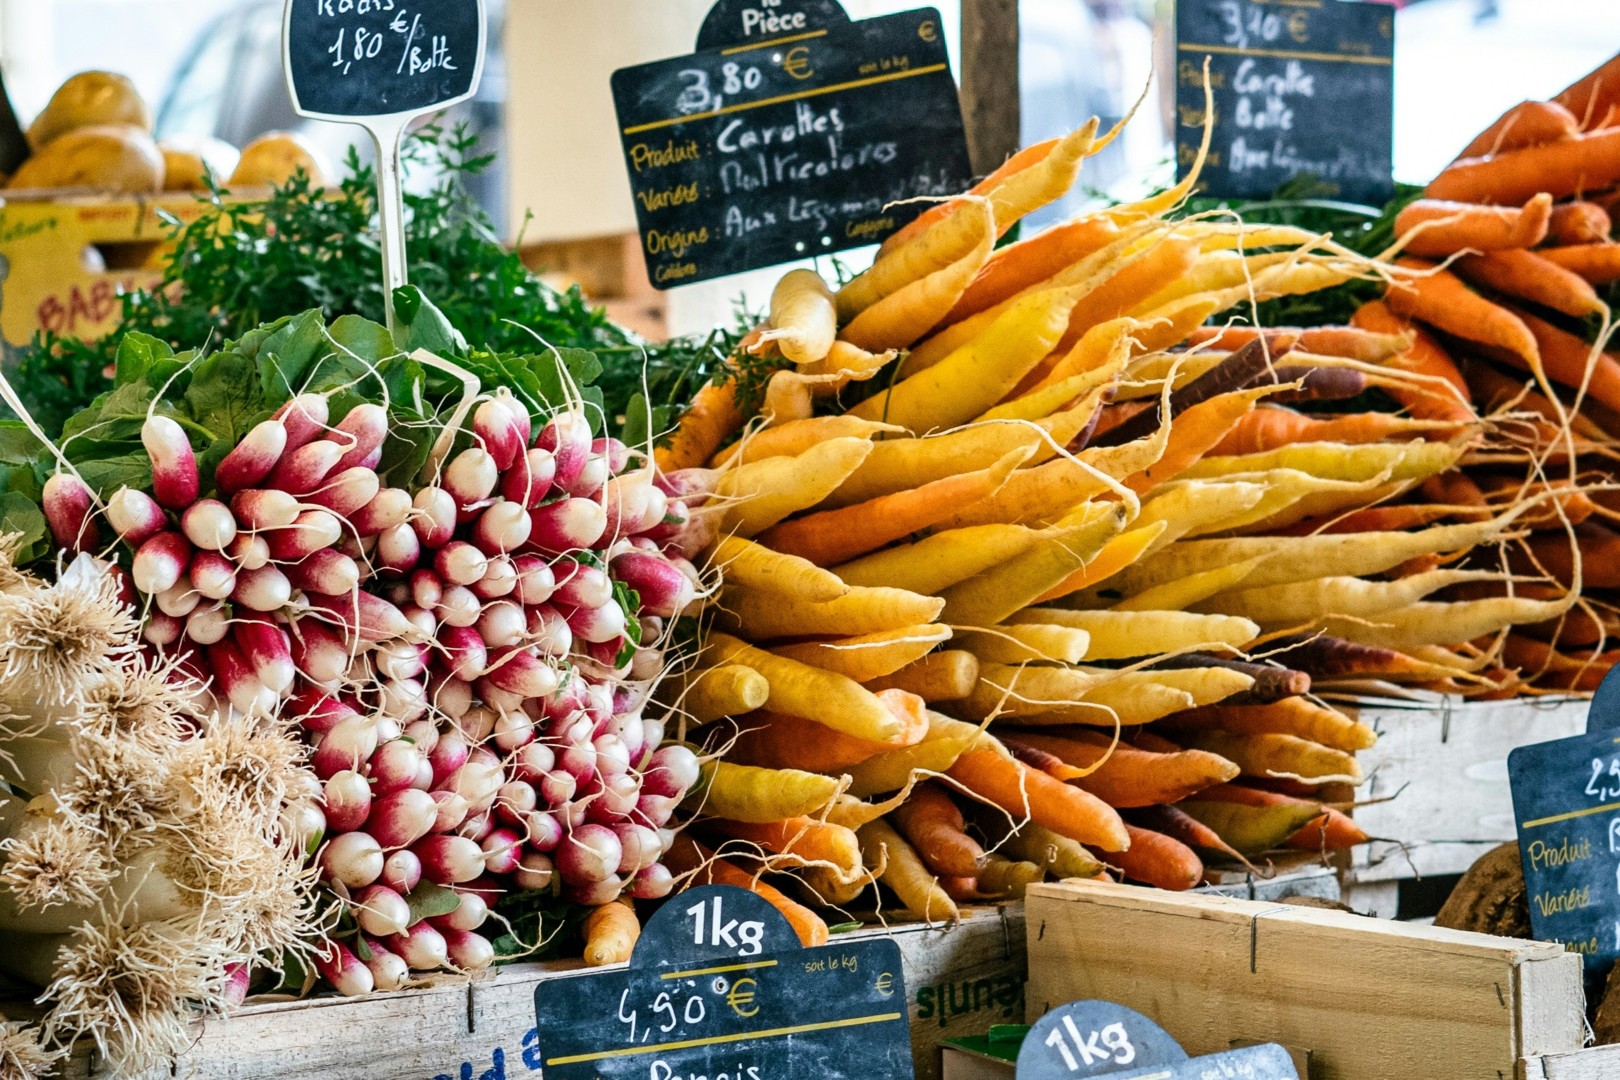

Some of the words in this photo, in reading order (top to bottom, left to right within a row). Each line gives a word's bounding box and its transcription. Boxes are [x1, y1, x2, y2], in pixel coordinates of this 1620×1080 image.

[741, 8, 806, 36] Pièce
[328, 27, 383, 75] 1,80
[676, 61, 762, 114] 3,80
[783, 46, 814, 80] €
[716, 101, 844, 152] Carottes
[630, 139, 699, 172] Produit
[646, 225, 710, 258] Origine
[1527, 836, 1594, 871] Produit
[1533, 885, 1591, 917] Variété
[686, 896, 765, 957] 1kg
[804, 962, 826, 974] soit
[828, 955, 839, 970] le
[841, 953, 859, 973] kg
[875, 972, 895, 997] €
[916, 976, 1025, 1028] éunis
[618, 988, 706, 1043] 4,90
[726, 977, 760, 1017] €
[1044, 1014, 1136, 1072] 1kg
